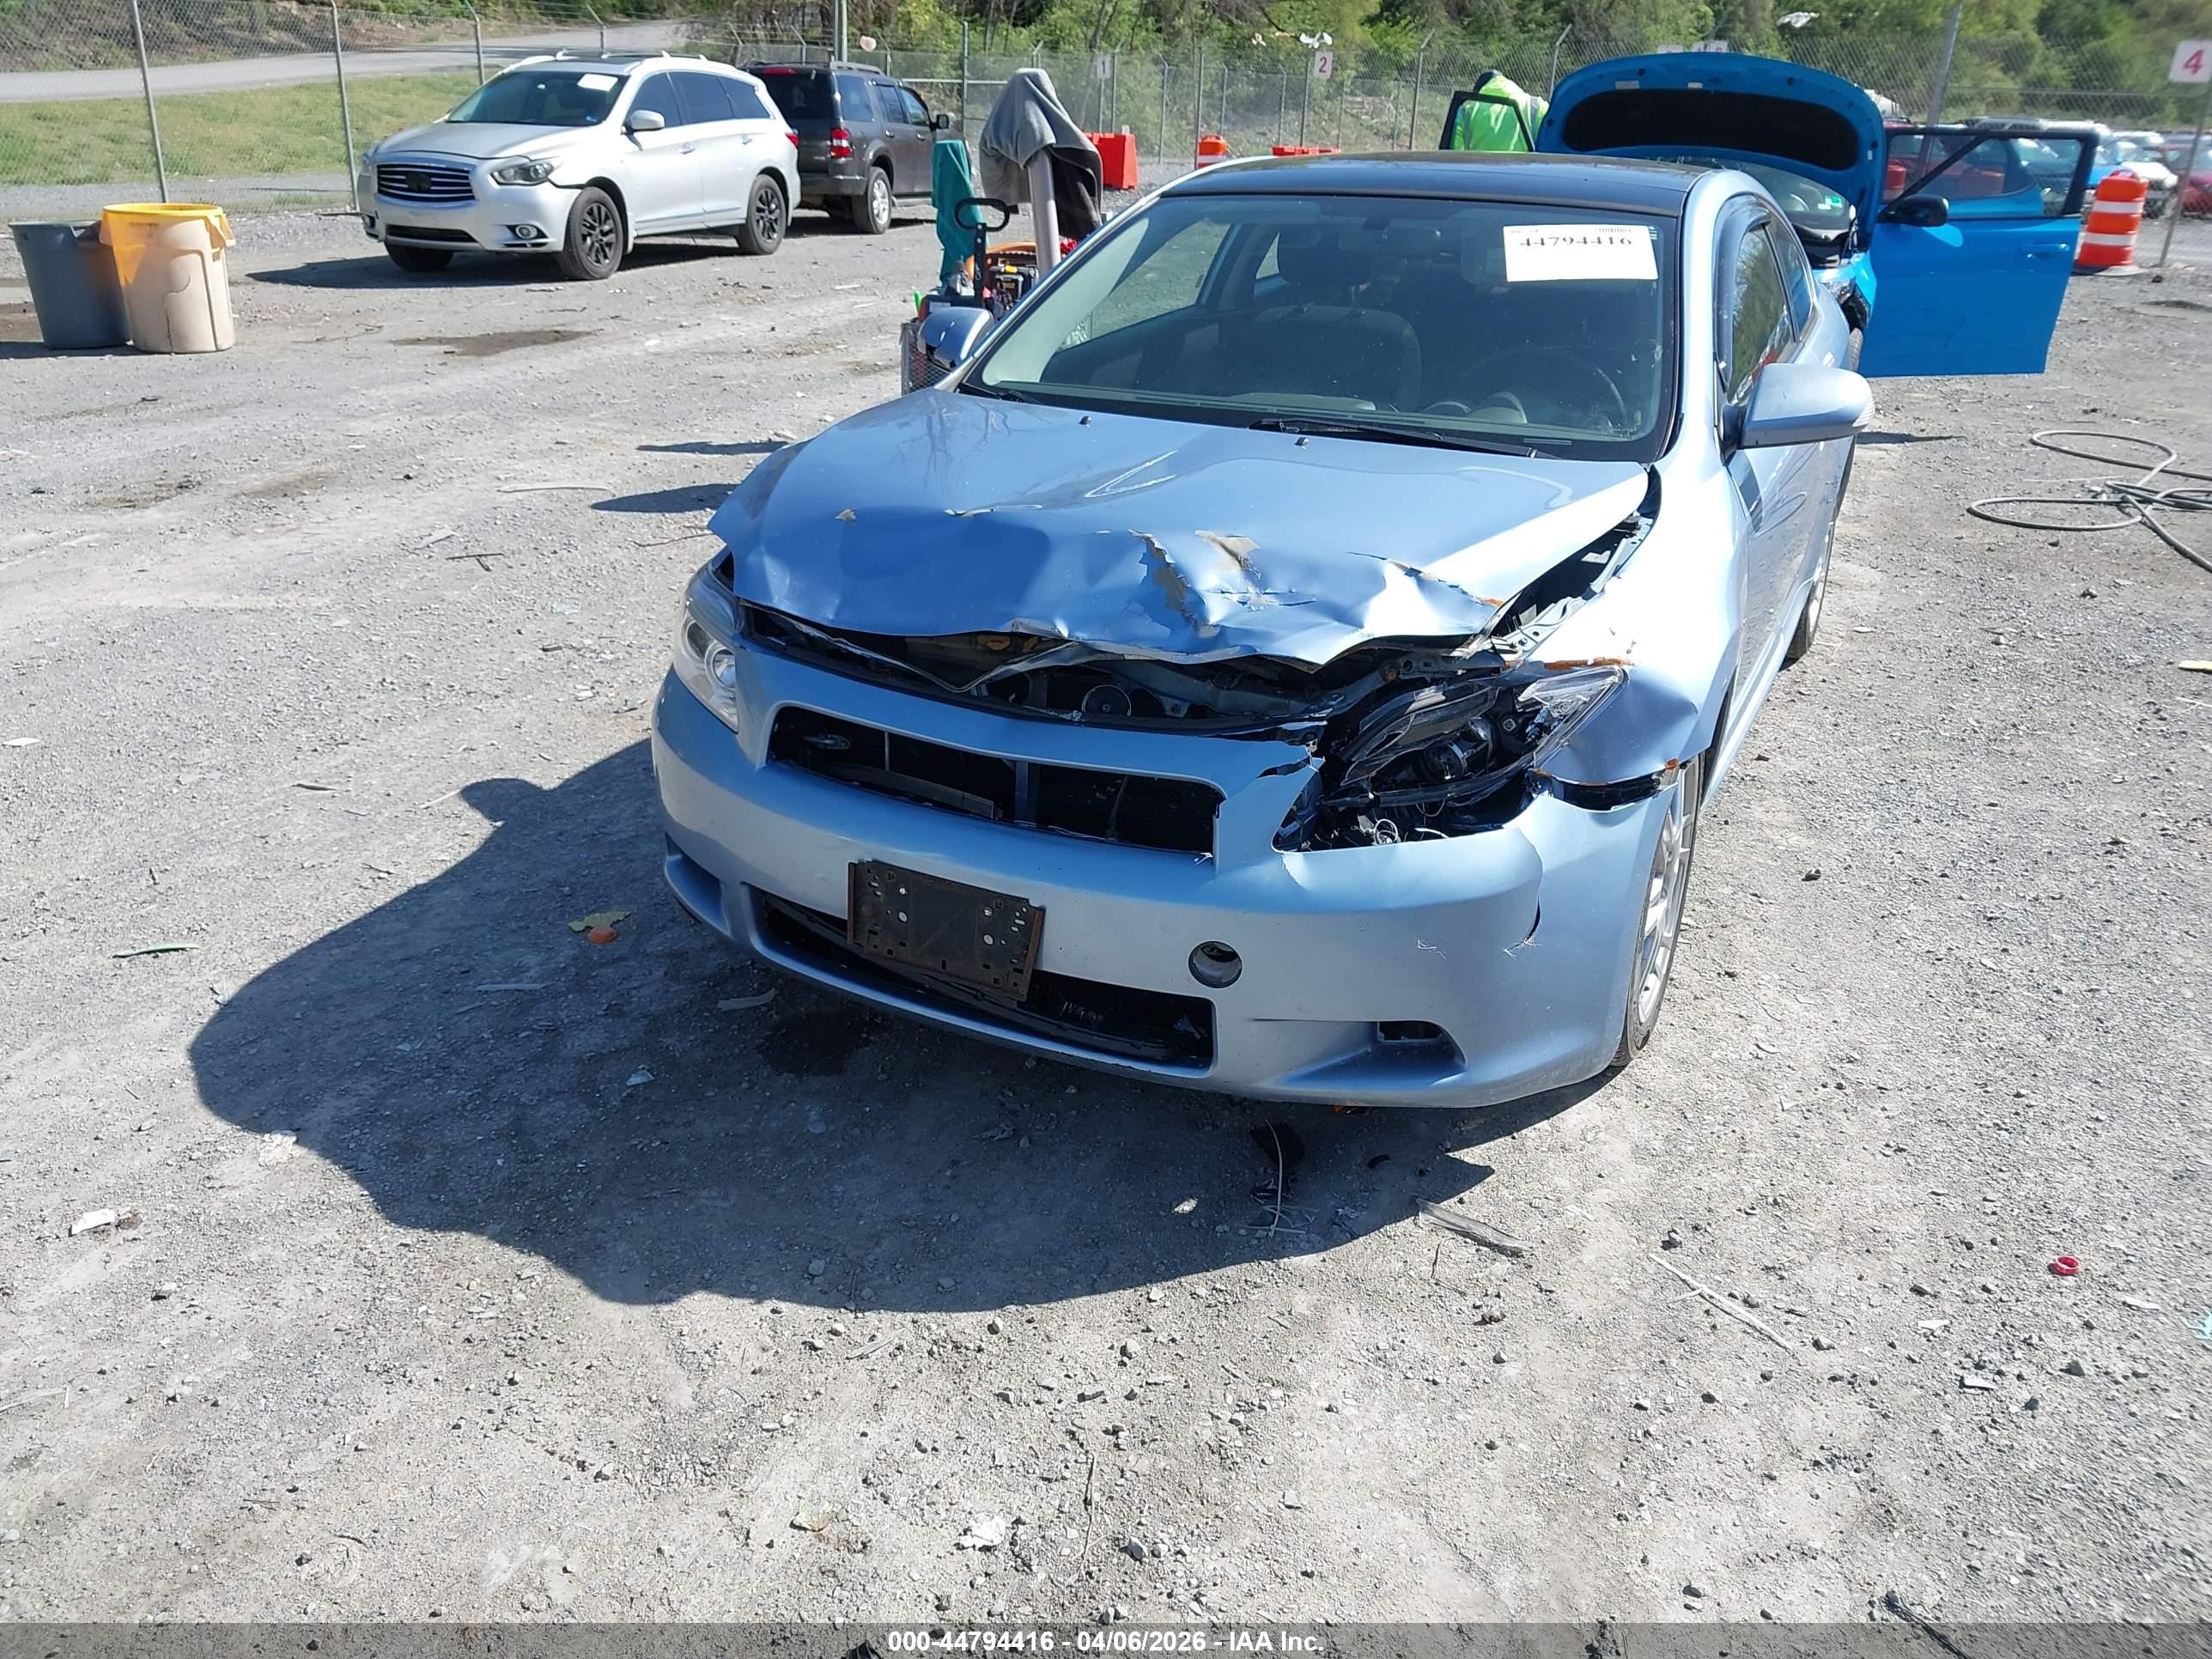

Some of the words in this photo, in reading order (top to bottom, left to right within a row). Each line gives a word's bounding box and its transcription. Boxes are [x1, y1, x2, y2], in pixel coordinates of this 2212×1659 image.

[1318, 56, 1328, 74] 2
[2183, 49, 2204, 76] 4
[1519, 235, 1632, 247] 44794416
